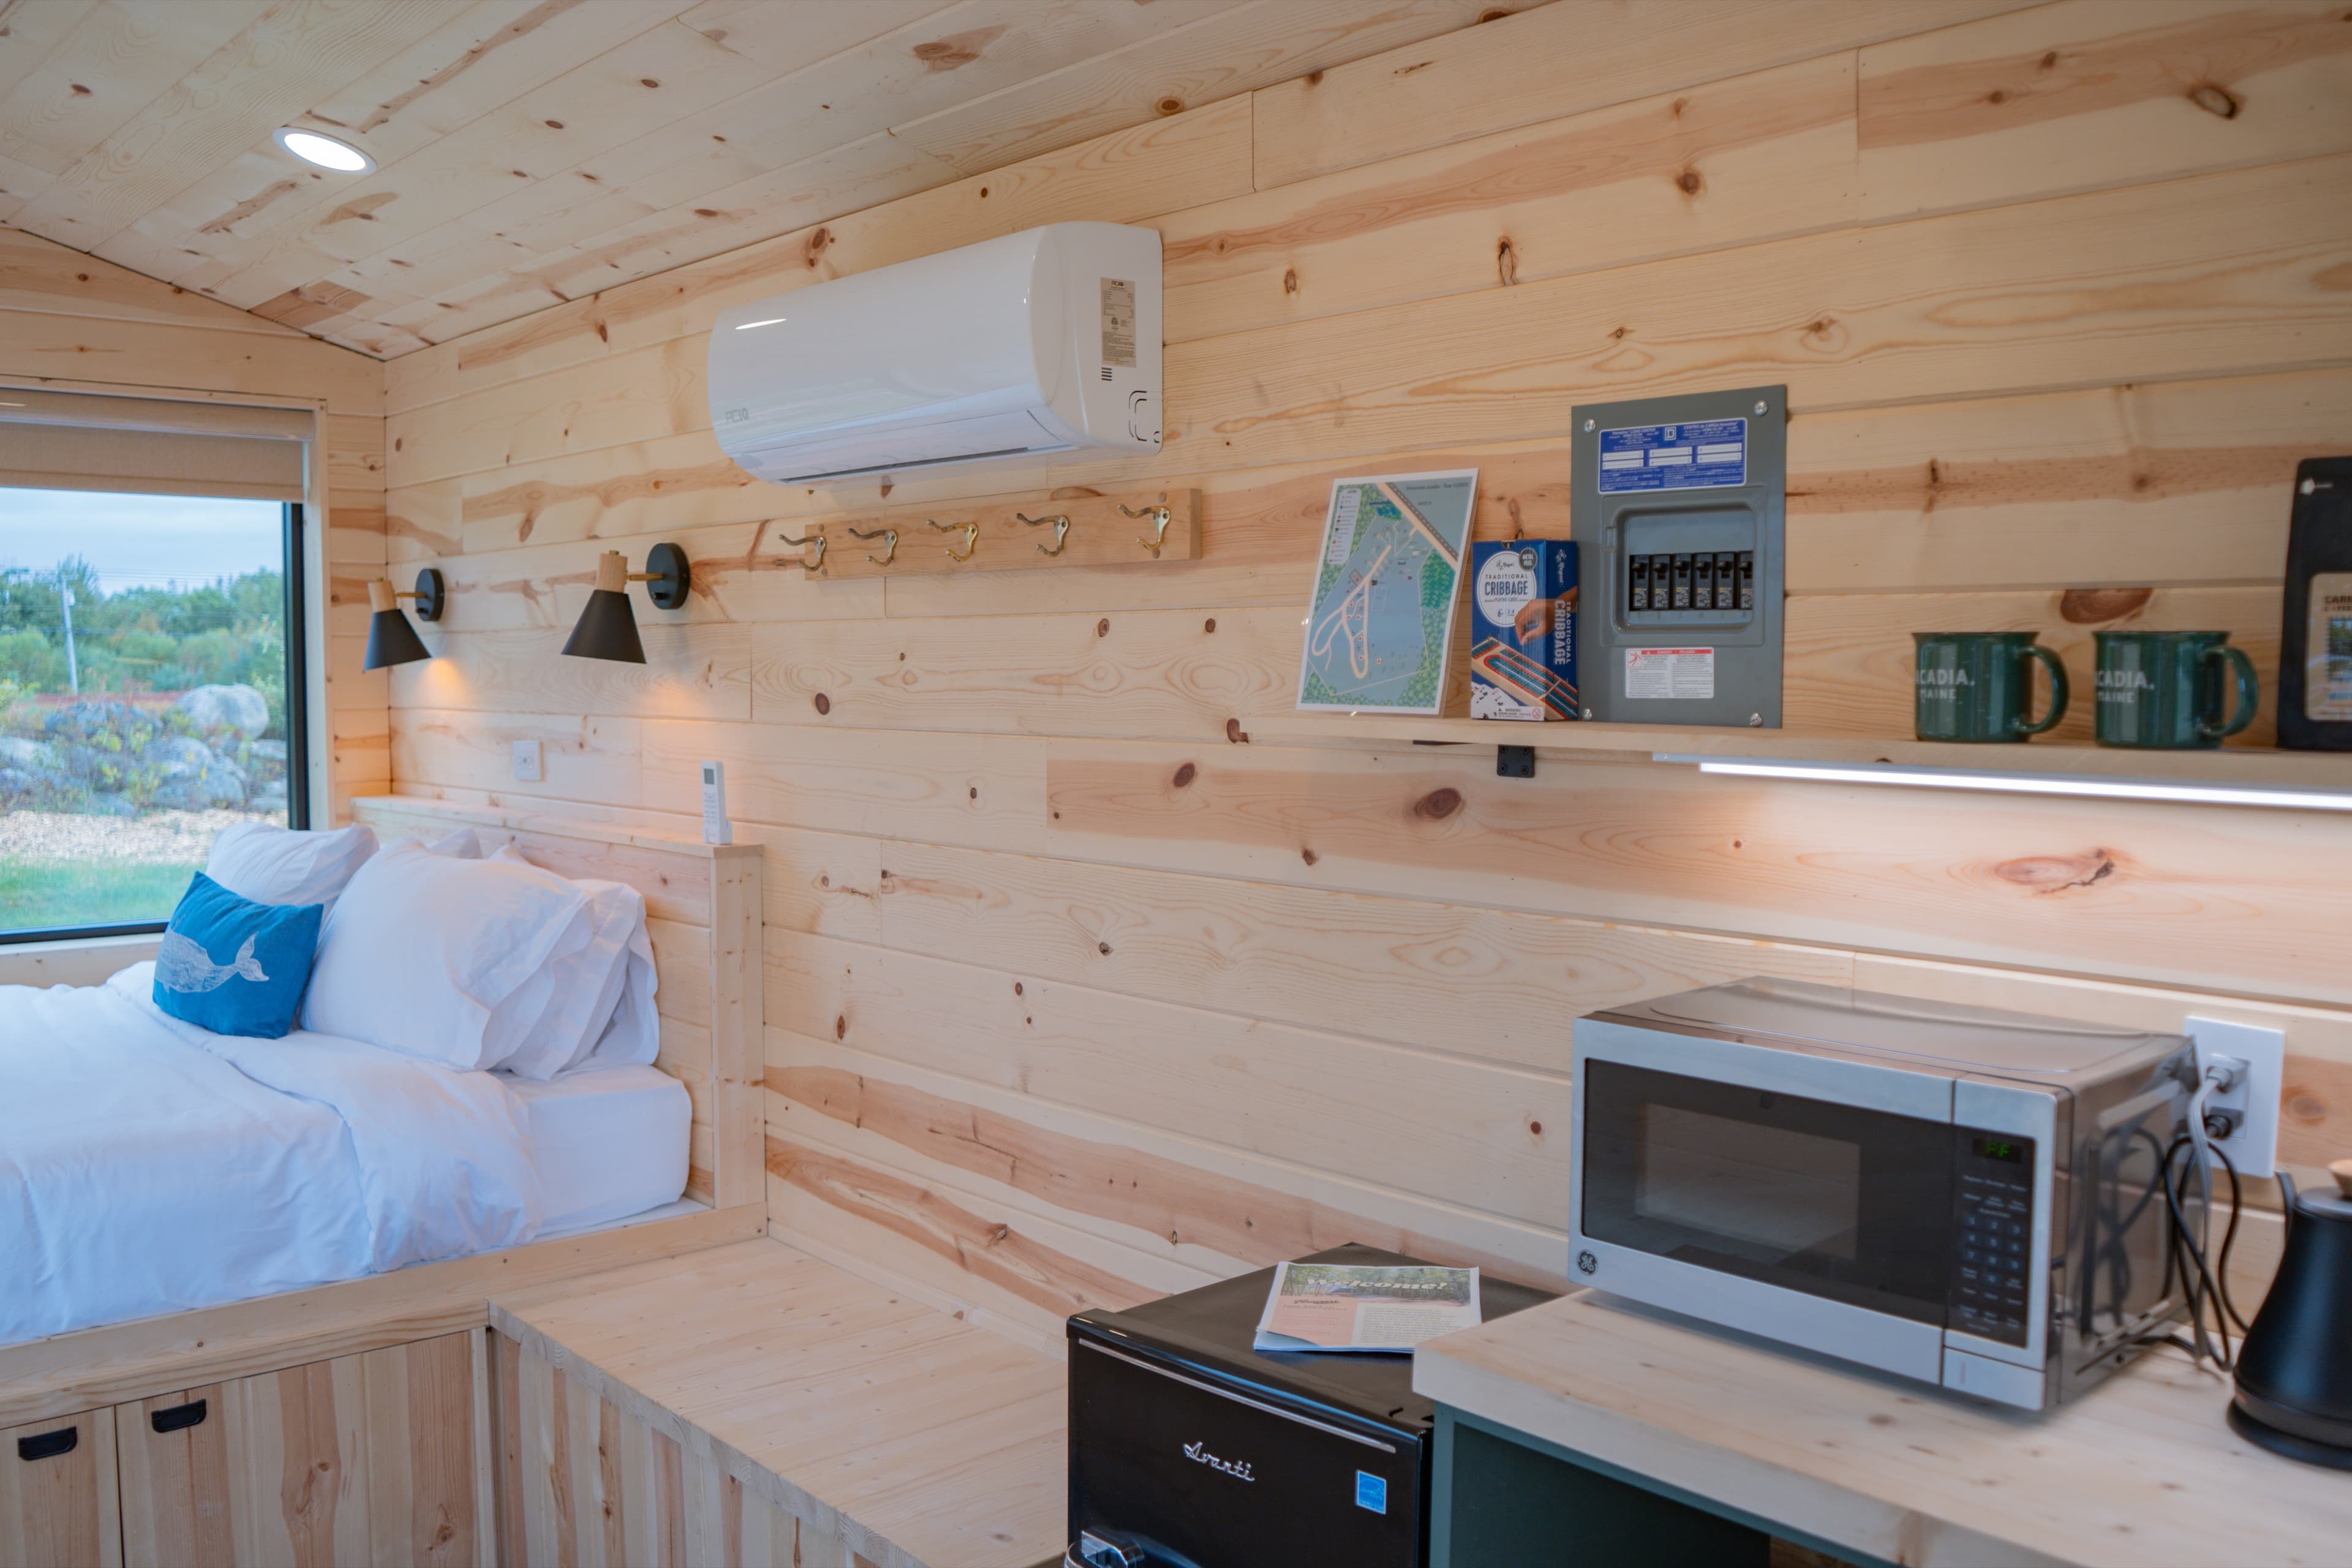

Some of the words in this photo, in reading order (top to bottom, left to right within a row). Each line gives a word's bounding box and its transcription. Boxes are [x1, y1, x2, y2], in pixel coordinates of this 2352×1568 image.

[1485, 581, 1528, 596] CRIBBAGE
[1555, 600, 1566, 665] CRIBBAGE
[2094, 671, 2155, 690] CADIA.
[1920, 688, 1956, 699] MAINE
[2097, 691, 2135, 703] MAINE
[1306, 1278, 1448, 1290] Welcome!
[1184, 1441, 1255, 1482] Avanti
